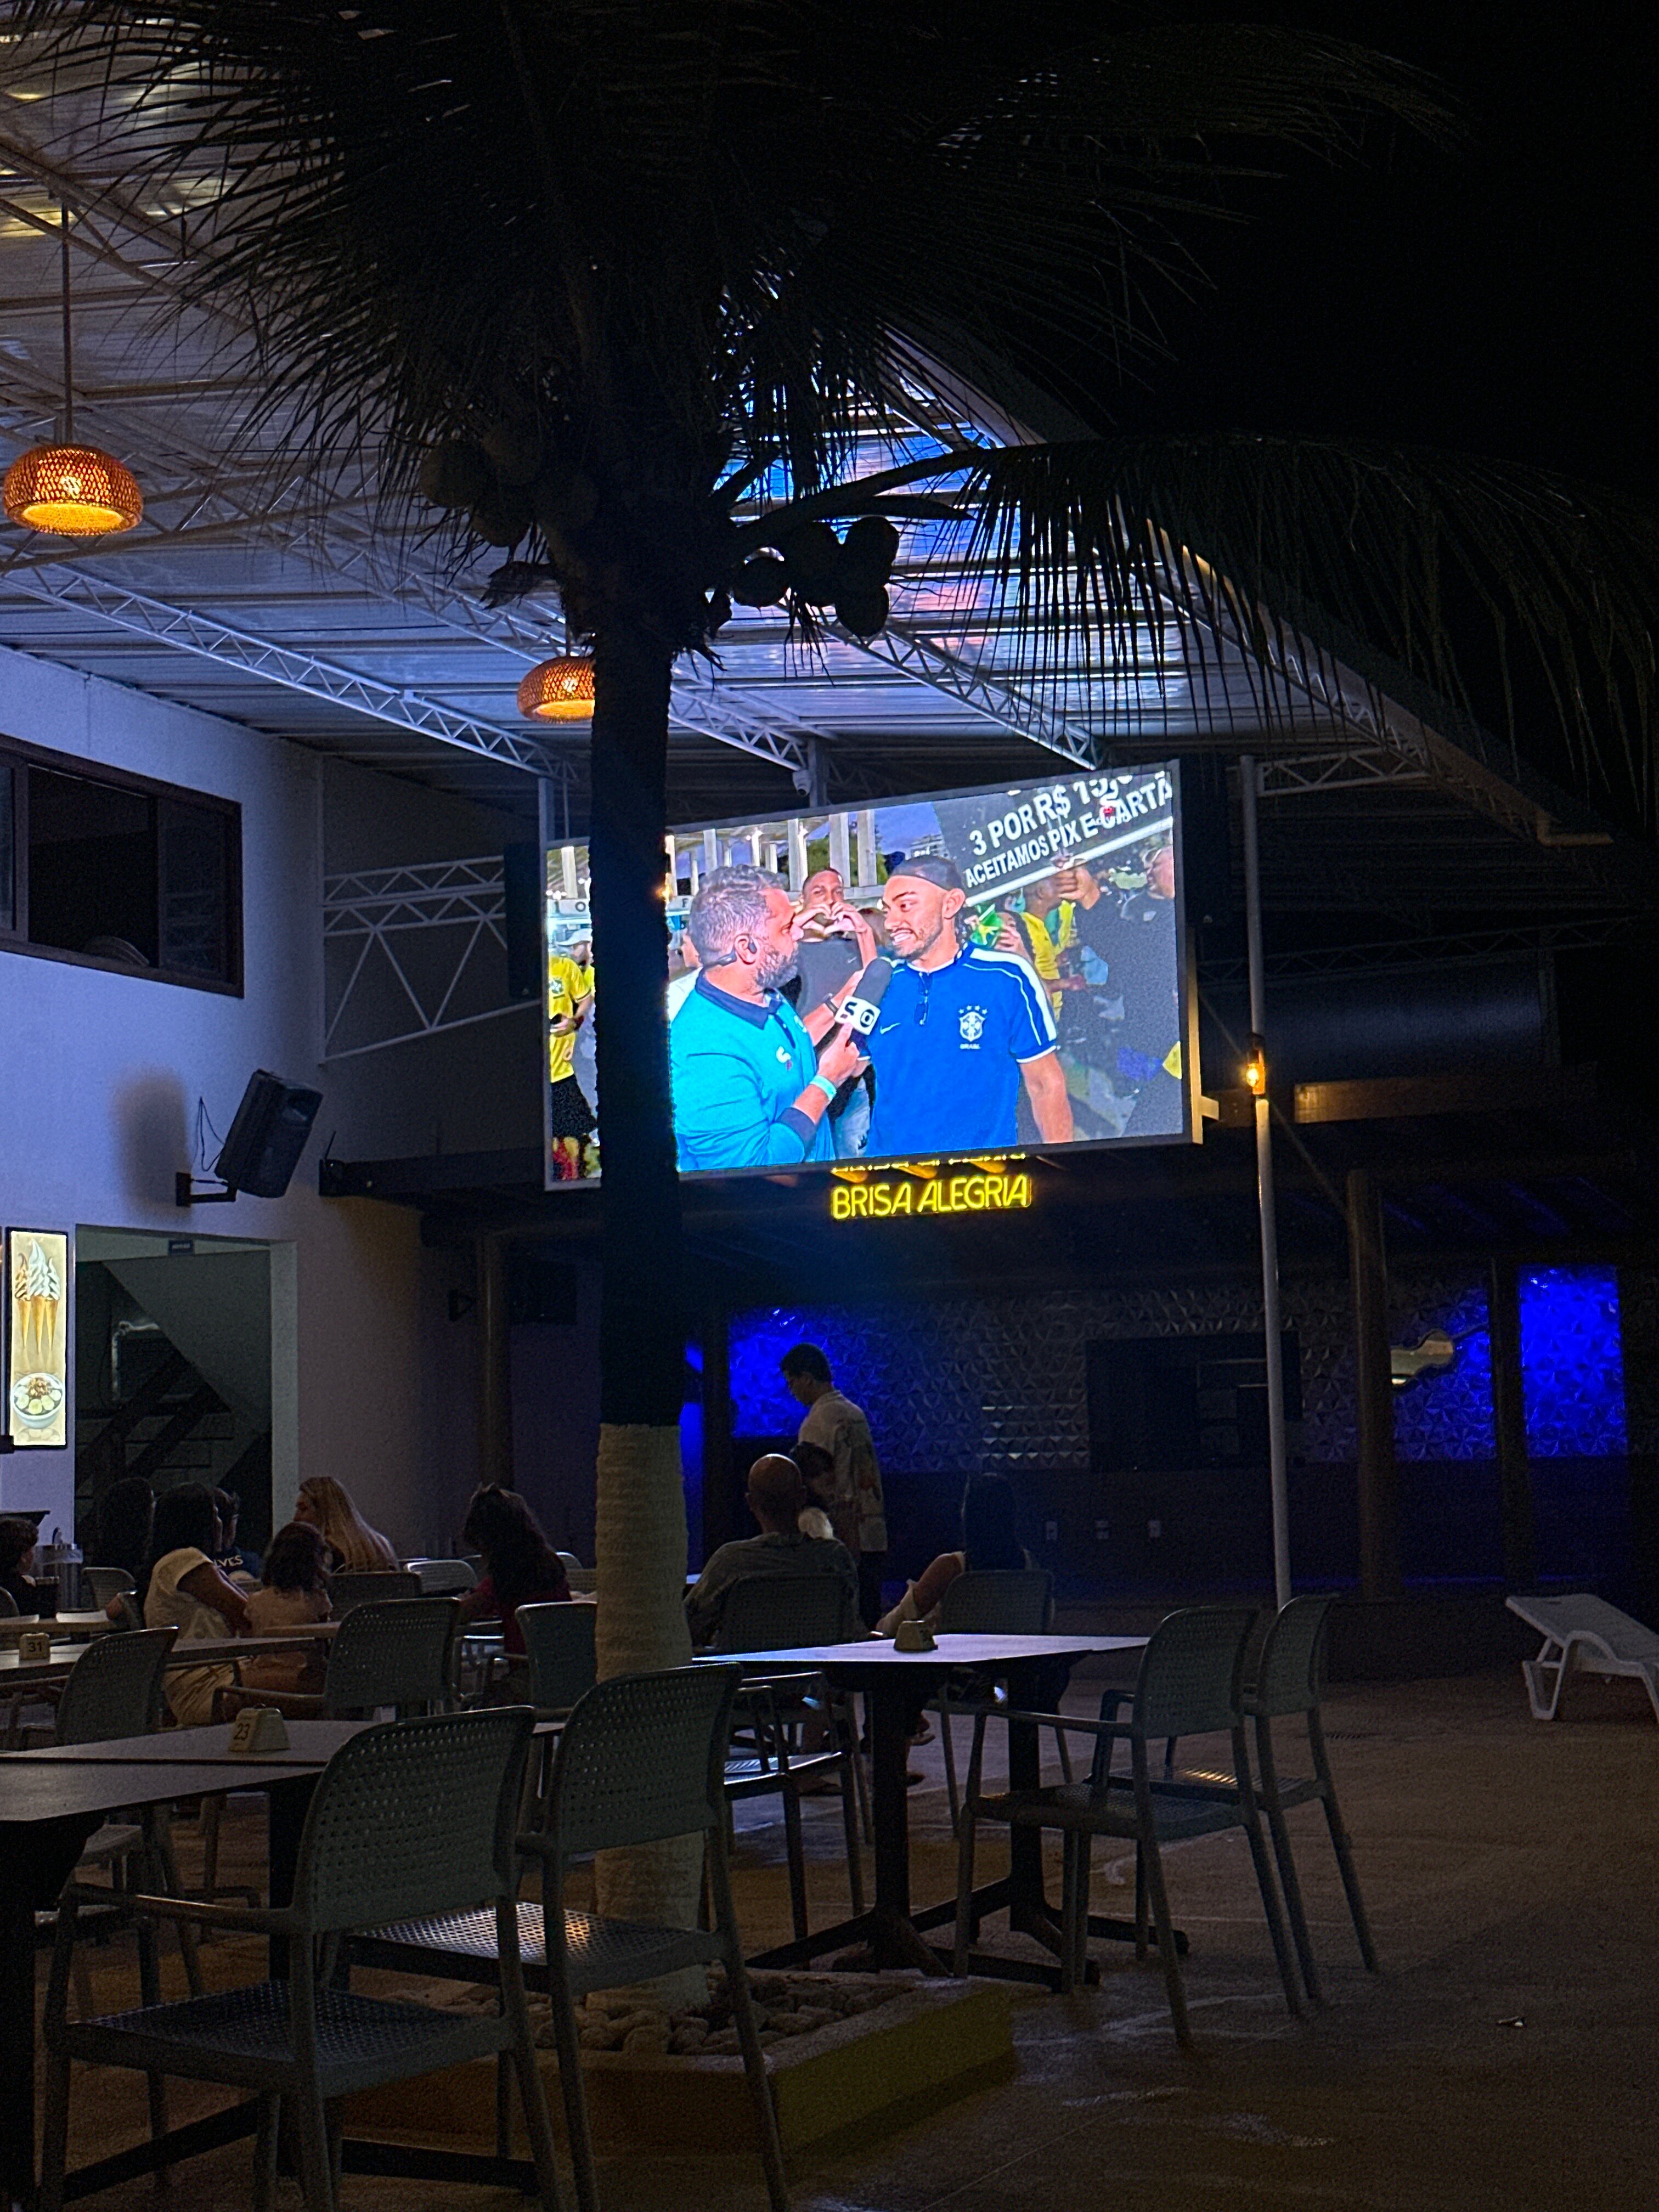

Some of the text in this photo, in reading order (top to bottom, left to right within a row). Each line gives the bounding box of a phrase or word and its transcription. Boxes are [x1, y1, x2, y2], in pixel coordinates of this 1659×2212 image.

[969, 830, 987, 856] 3
[988, 804, 1038, 848] POR
[1033, 784, 1070, 825] R$
[964, 834, 1050, 888] ACEITAMOS
[1047, 820, 1082, 851] PIX
[1079, 812, 1098, 839] E
[832, 1173, 1029, 1220] BRISA ALEGRIA
[29, 1642, 42, 1652] 31
[234, 1723, 250, 1740] 23
